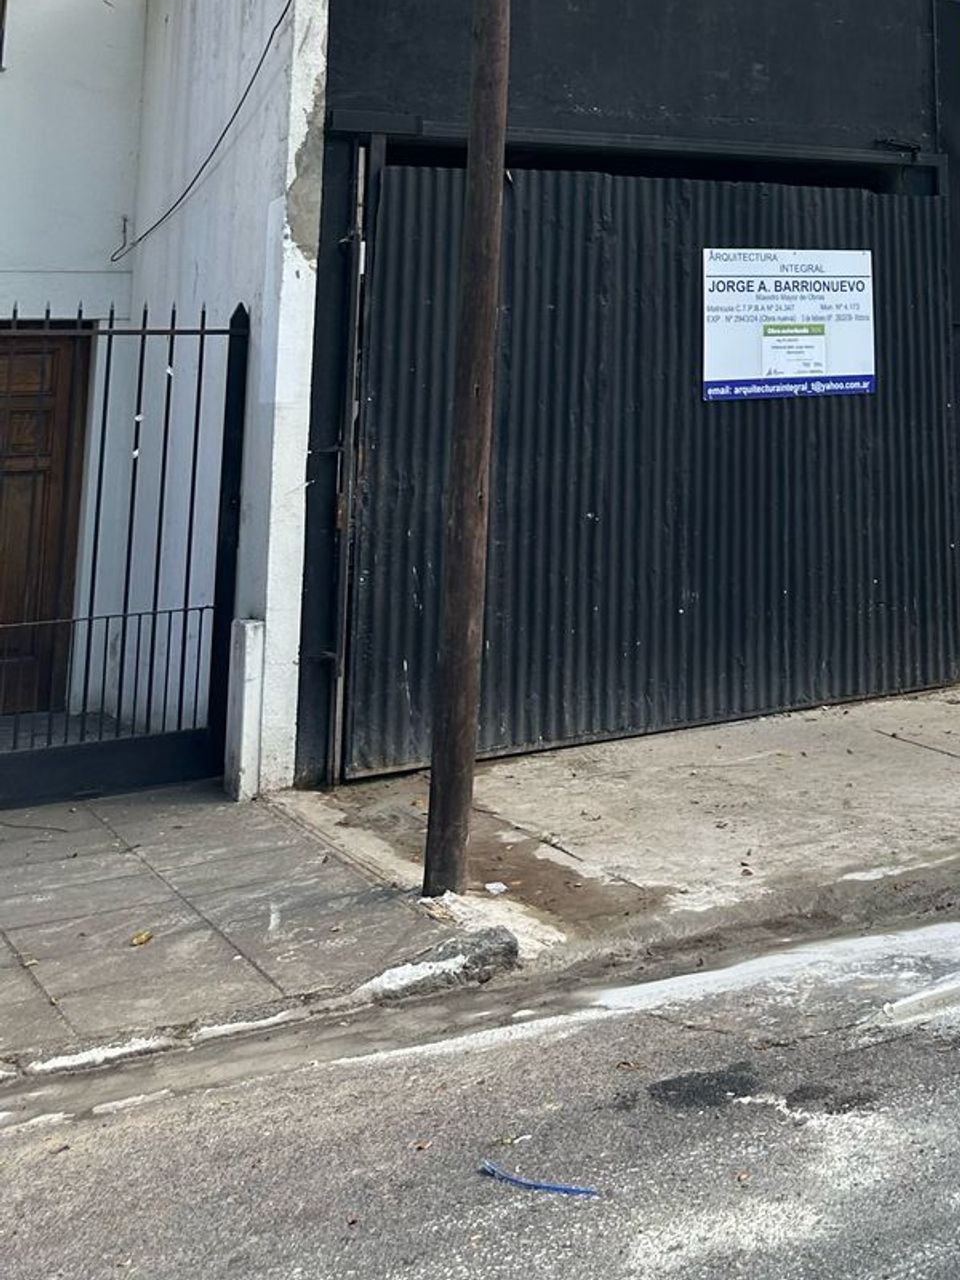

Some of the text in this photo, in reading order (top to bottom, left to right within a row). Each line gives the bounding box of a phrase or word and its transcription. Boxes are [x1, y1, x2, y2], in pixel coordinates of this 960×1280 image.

[708, 250, 778, 262] ARQUITECTURA
[780, 264, 825, 273] INTEGRAL
[708, 280, 866, 293] JORGE A. BARRIONUEVO
[707, 386, 732, 395] email:
